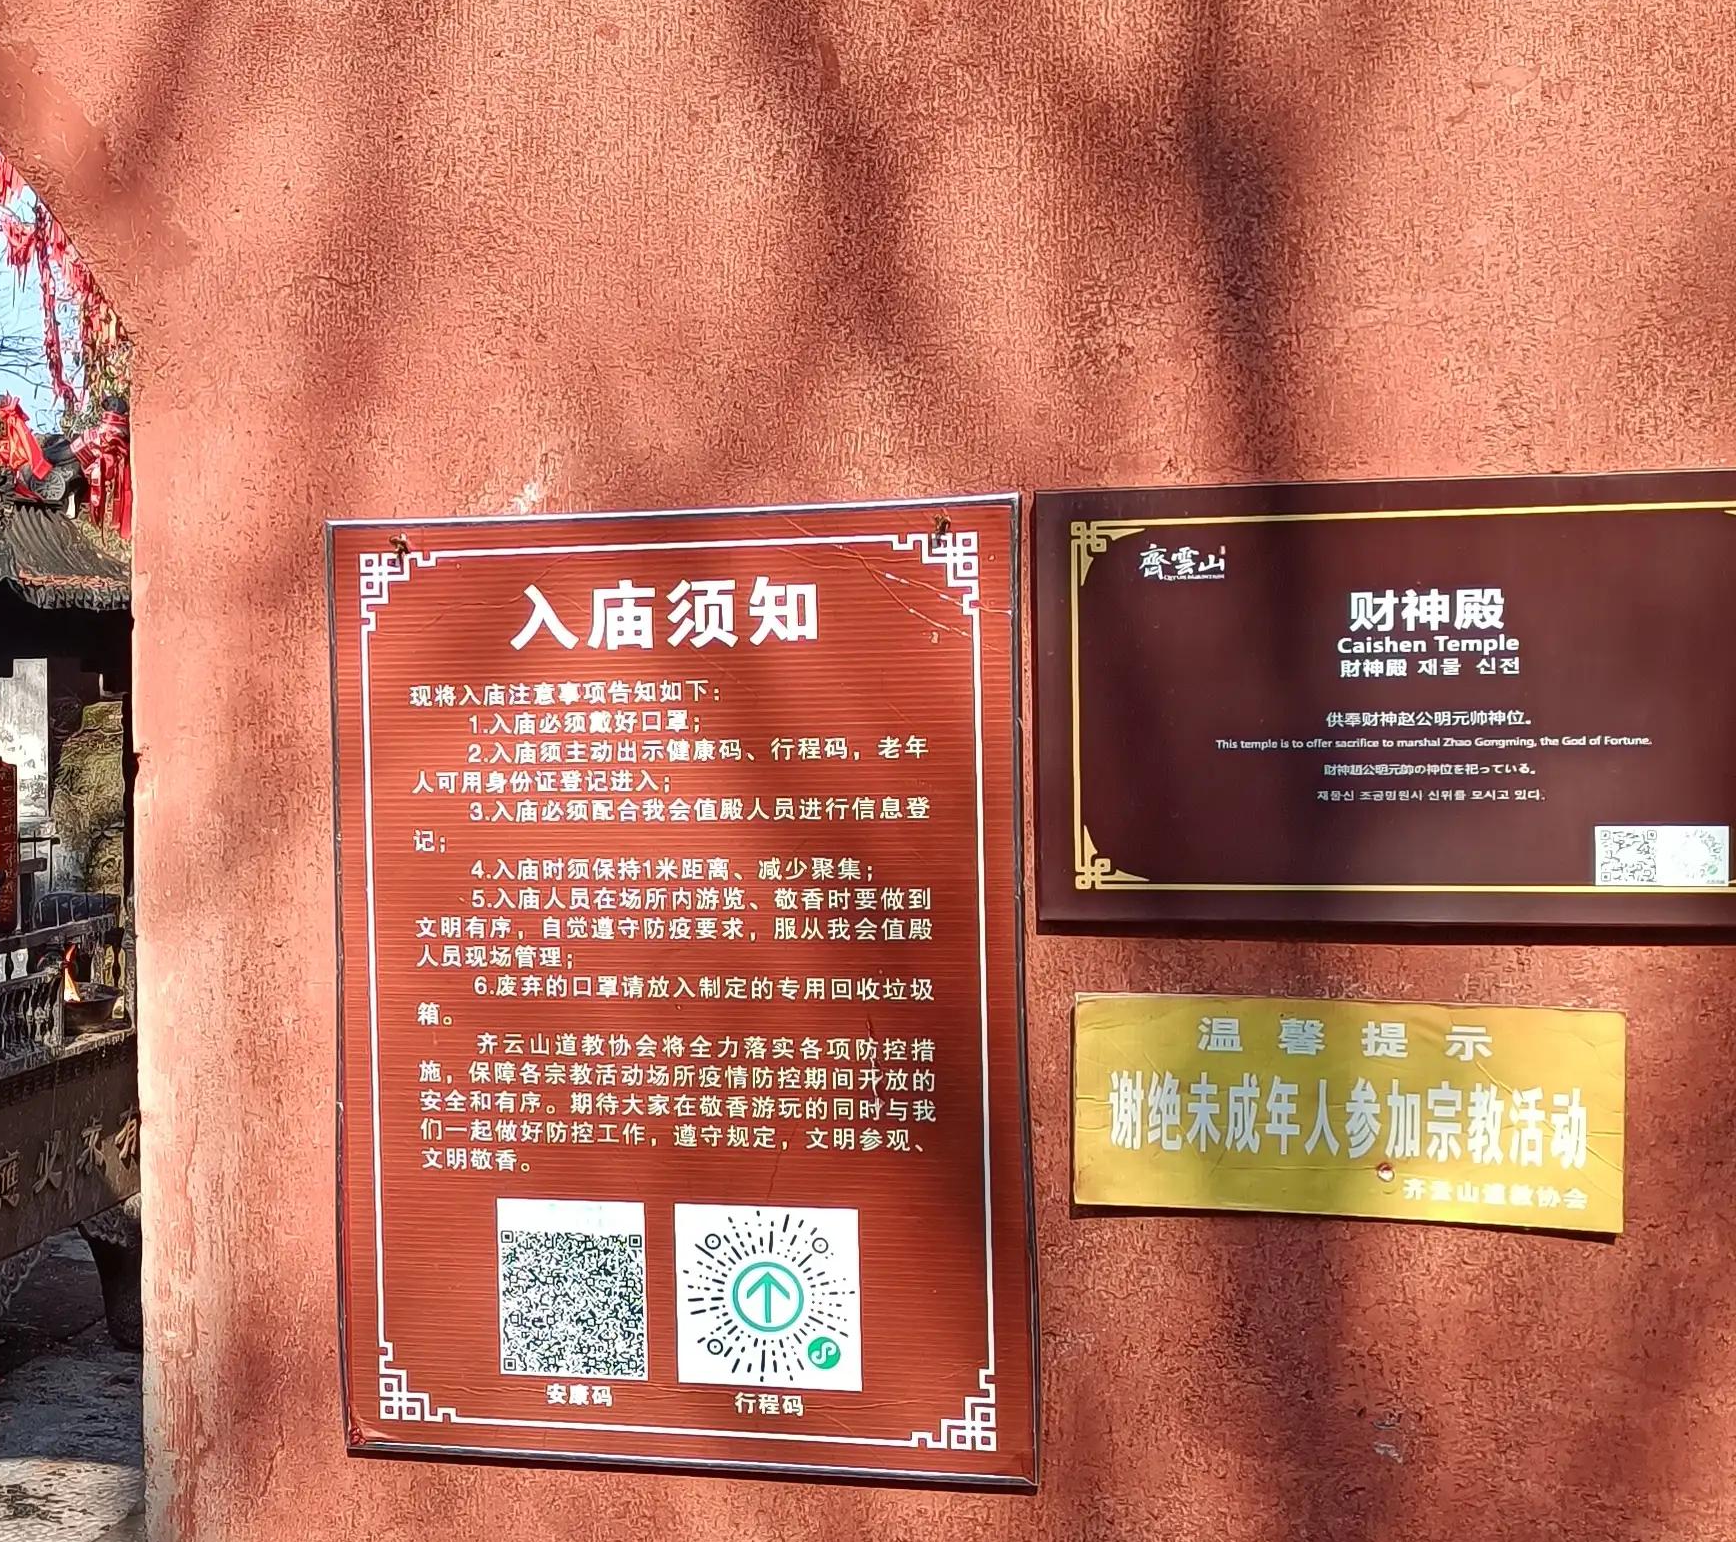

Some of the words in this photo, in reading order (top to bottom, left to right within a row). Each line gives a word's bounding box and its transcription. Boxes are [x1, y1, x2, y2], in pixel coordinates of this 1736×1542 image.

[509, 576, 819, 652] 入庙须知
[1349, 588, 1505, 632] 财神殿
[1337, 636, 1427, 654] Caishen
[1434, 634, 1520, 656] Temple
[1340, 659, 1407, 678] 財神殿
[1417, 658, 1462, 676] 재물
[1476, 657, 1520, 675] 신전
[409, 679, 721, 707] 现将入庙注意事项告知如下：
[1216, 739, 1238, 749] This
[1240, 739, 1277, 751] temple
[1280, 739, 1289, 749] is
[1292, 740, 1303, 749] to
[1306, 738, 1333, 748] offer
[1335, 737, 1379, 748] sacrifice
[1382, 739, 1394, 747] to
[1397, 737, 1440, 747] marshal
[1443, 737, 1472, 747] Zhao
[1539, 737, 1559, 747] the
[1562, 736, 1586, 746] God
[1589, 735, 1601, 746] of
[469, 797, 931, 823] 3.入庙必须配合我会值殿人员进行信息登
[474, 974, 935, 1002] 6.废弃的口罩请放入制定的专用回收垃圾
[417, 1002, 454, 1027] 箱。
[477, 1032, 936, 1062] 齐云山道教协会将全力落实各项防控措
[1198, 1016, 1494, 1061] 温馨提示
[1108, 1068, 1589, 1170] 谢绝未成年人参加宗教活动
[422, 1148, 532, 1173] 文明敬香。
[546, 1383, 614, 1407] 安康码
[734, 1391, 804, 1417] 行程码
